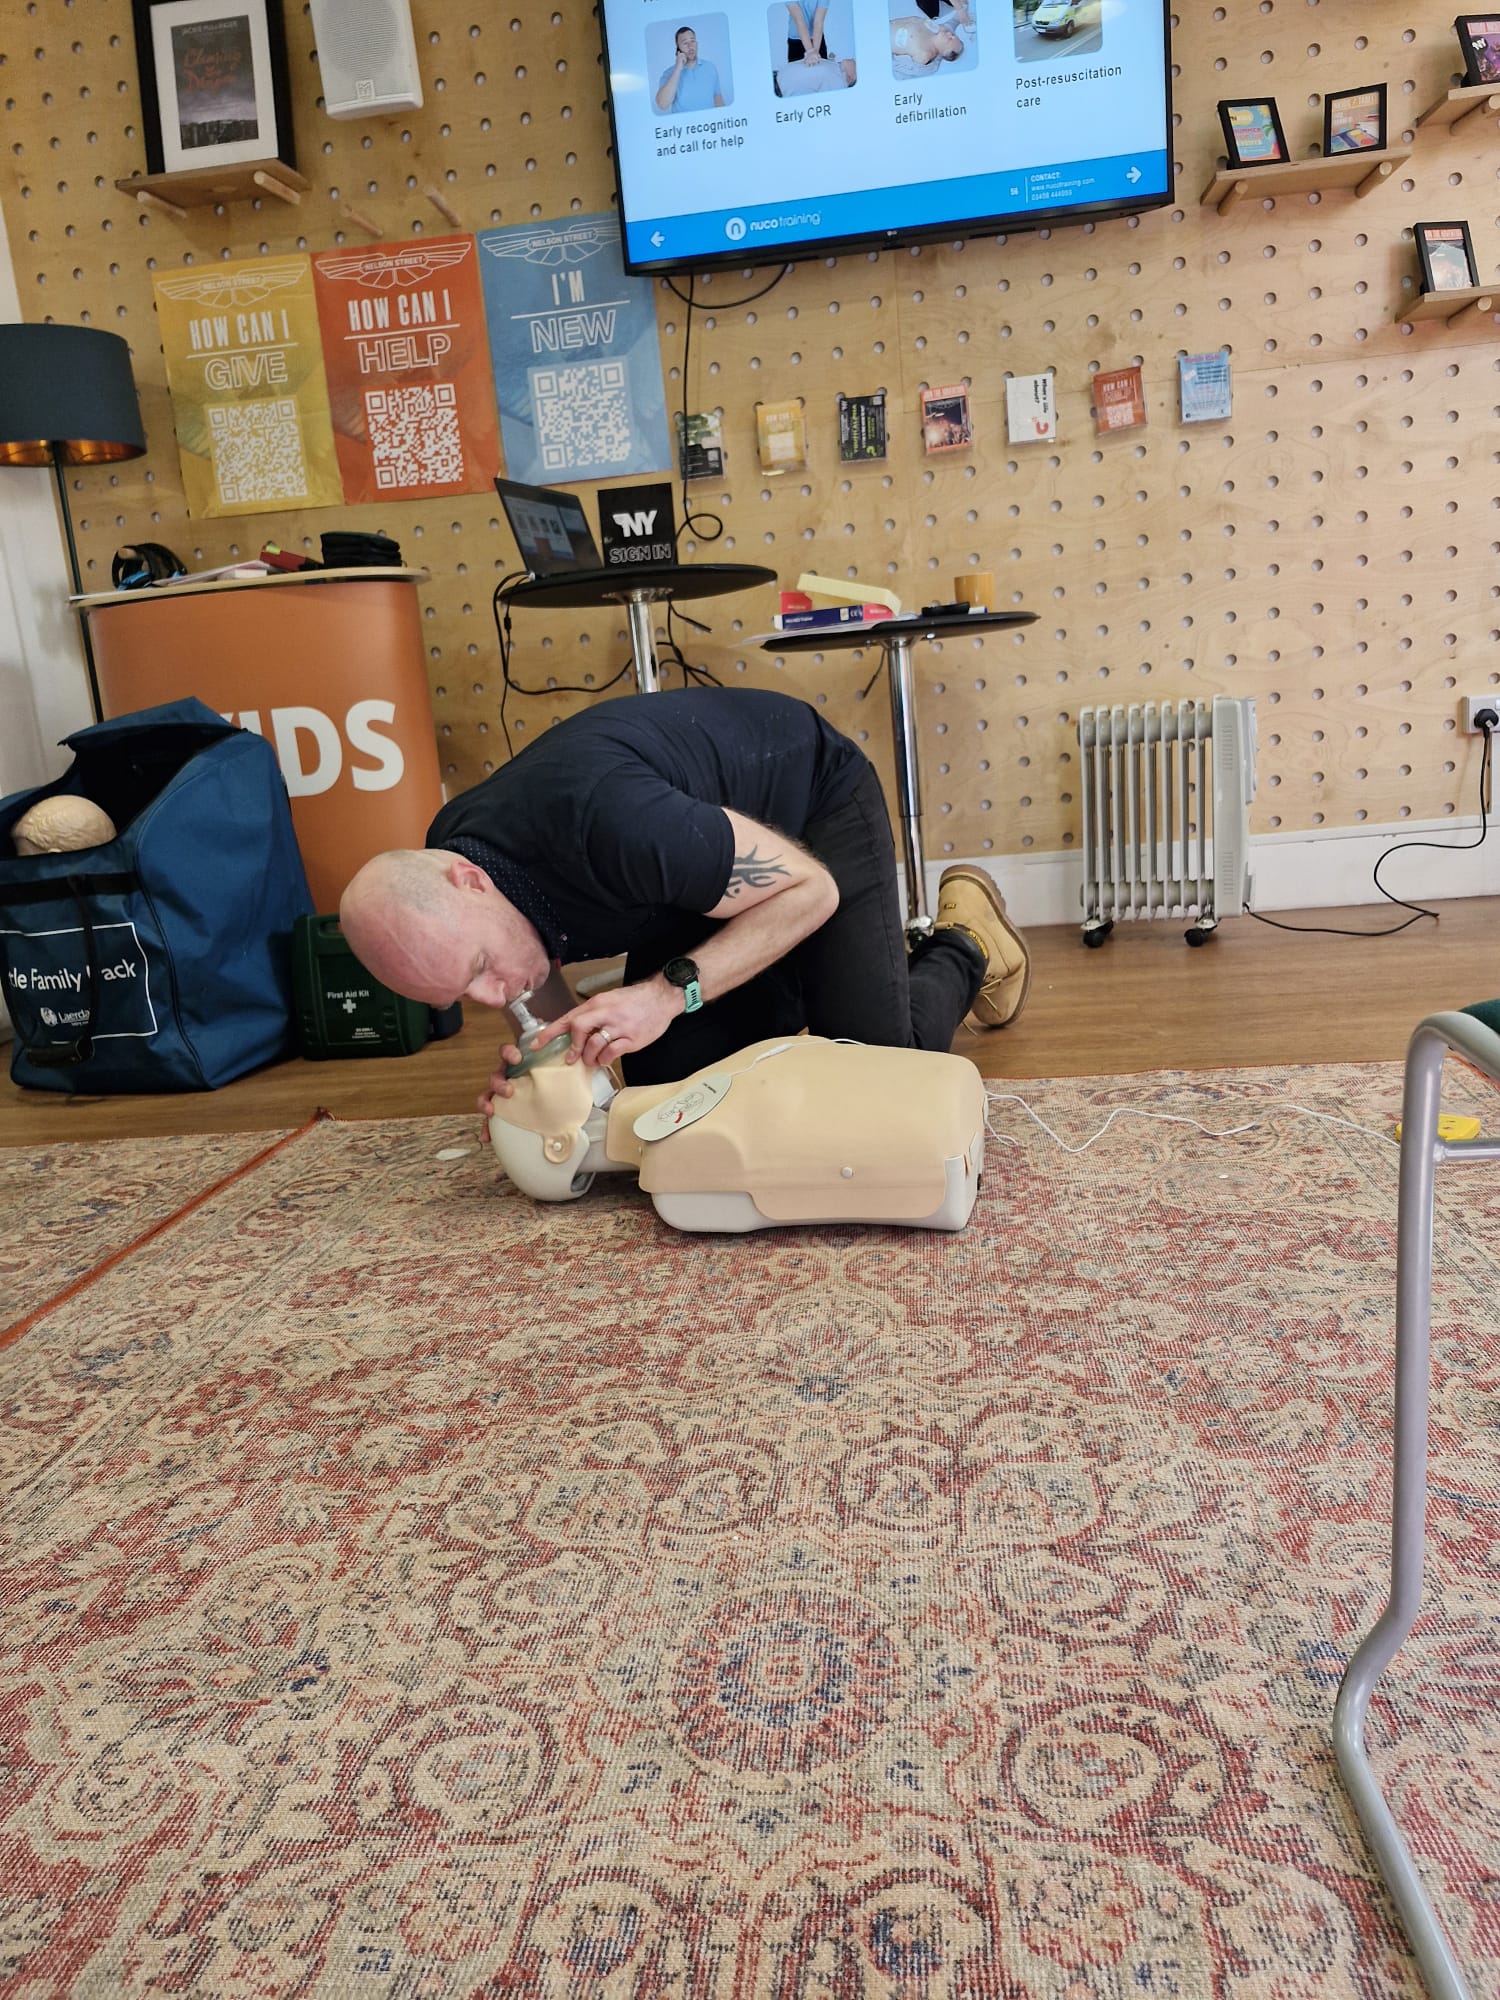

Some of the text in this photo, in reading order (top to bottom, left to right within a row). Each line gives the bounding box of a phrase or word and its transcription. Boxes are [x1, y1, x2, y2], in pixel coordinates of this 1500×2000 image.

[1015, 64, 1122, 90] Post-resuscitation
[893, 92, 923, 106] Early
[1016, 96, 1041, 108] care
[775, 104, 832, 123] Early CPR
[895, 104, 967, 124] defibrillation
[655, 116, 748, 139] Early recognition
[656, 135, 744, 157] and call for help
[531, 231, 594, 248] NELSON STREET
[364, 256, 424, 271] NELSON STREET
[202, 276, 261, 290] NELSON STREET
[551, 270, 585, 306] I'M
[348, 288, 452, 332] HOW CAN I
[189, 308, 290, 351] HOW CAN I
[530, 309, 617, 353] NEW
[358, 333, 451, 374] HELP
[204, 351, 289, 391] GIVE
[609, 543, 672, 564] SIGN IN
[31, 967, 81, 993] Family
[327, 989, 370, 999] First Aid Kit
[58, 1008, 91, 1023] Laerda
